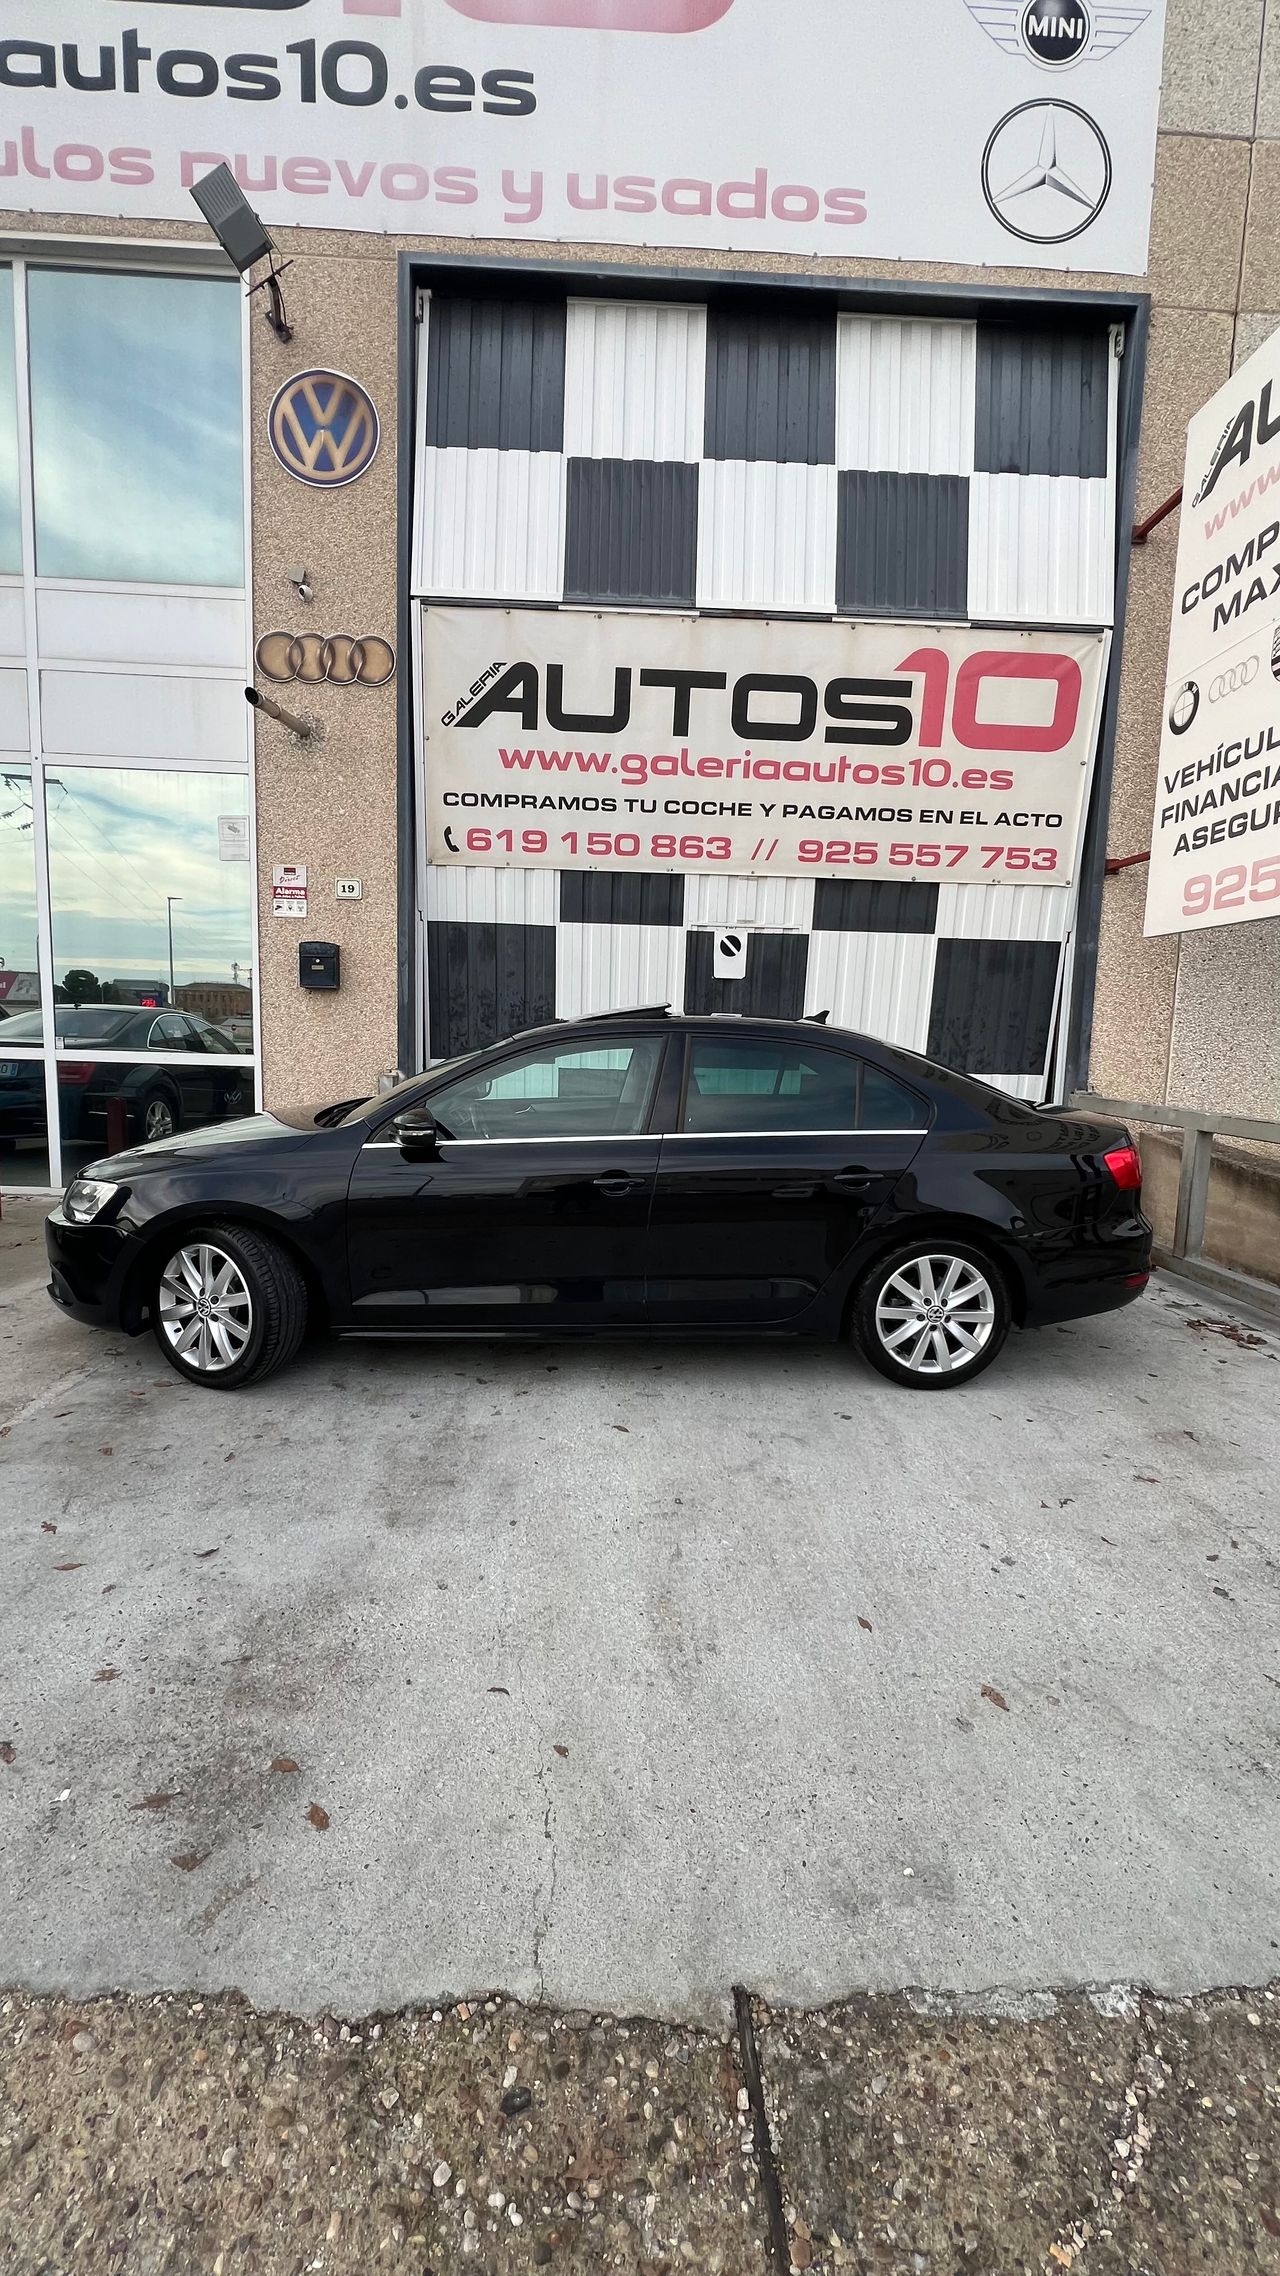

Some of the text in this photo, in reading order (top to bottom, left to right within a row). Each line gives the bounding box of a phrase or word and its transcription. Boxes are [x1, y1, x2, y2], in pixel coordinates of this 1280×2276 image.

[1028, 14, 1083, 39] MINI
[180, 151, 478, 205] nuevos
[502, 169, 543, 224] y
[566, 168, 867, 225] usados
[441, 661, 508, 727] GALERIA
[453, 647, 1082, 753] AUTOS10
[498, 748, 1014, 790] www.galeriaautos10.es
[443, 792, 1063, 828] COMPRAMOS TU COCHE Y PAGAMOS EN EL ACTO
[466, 828, 548, 853] 619
[561, 831, 640, 857] 150
[651, 835, 732, 860] 863
[798, 839, 878, 865] 925
[889, 843, 969, 868] 557
[981, 846, 1057, 871] 753
[275, 887, 306, 896] Alarma
[340, 884, 355, 893] 19
[1182, 855, 1280, 916] 925
